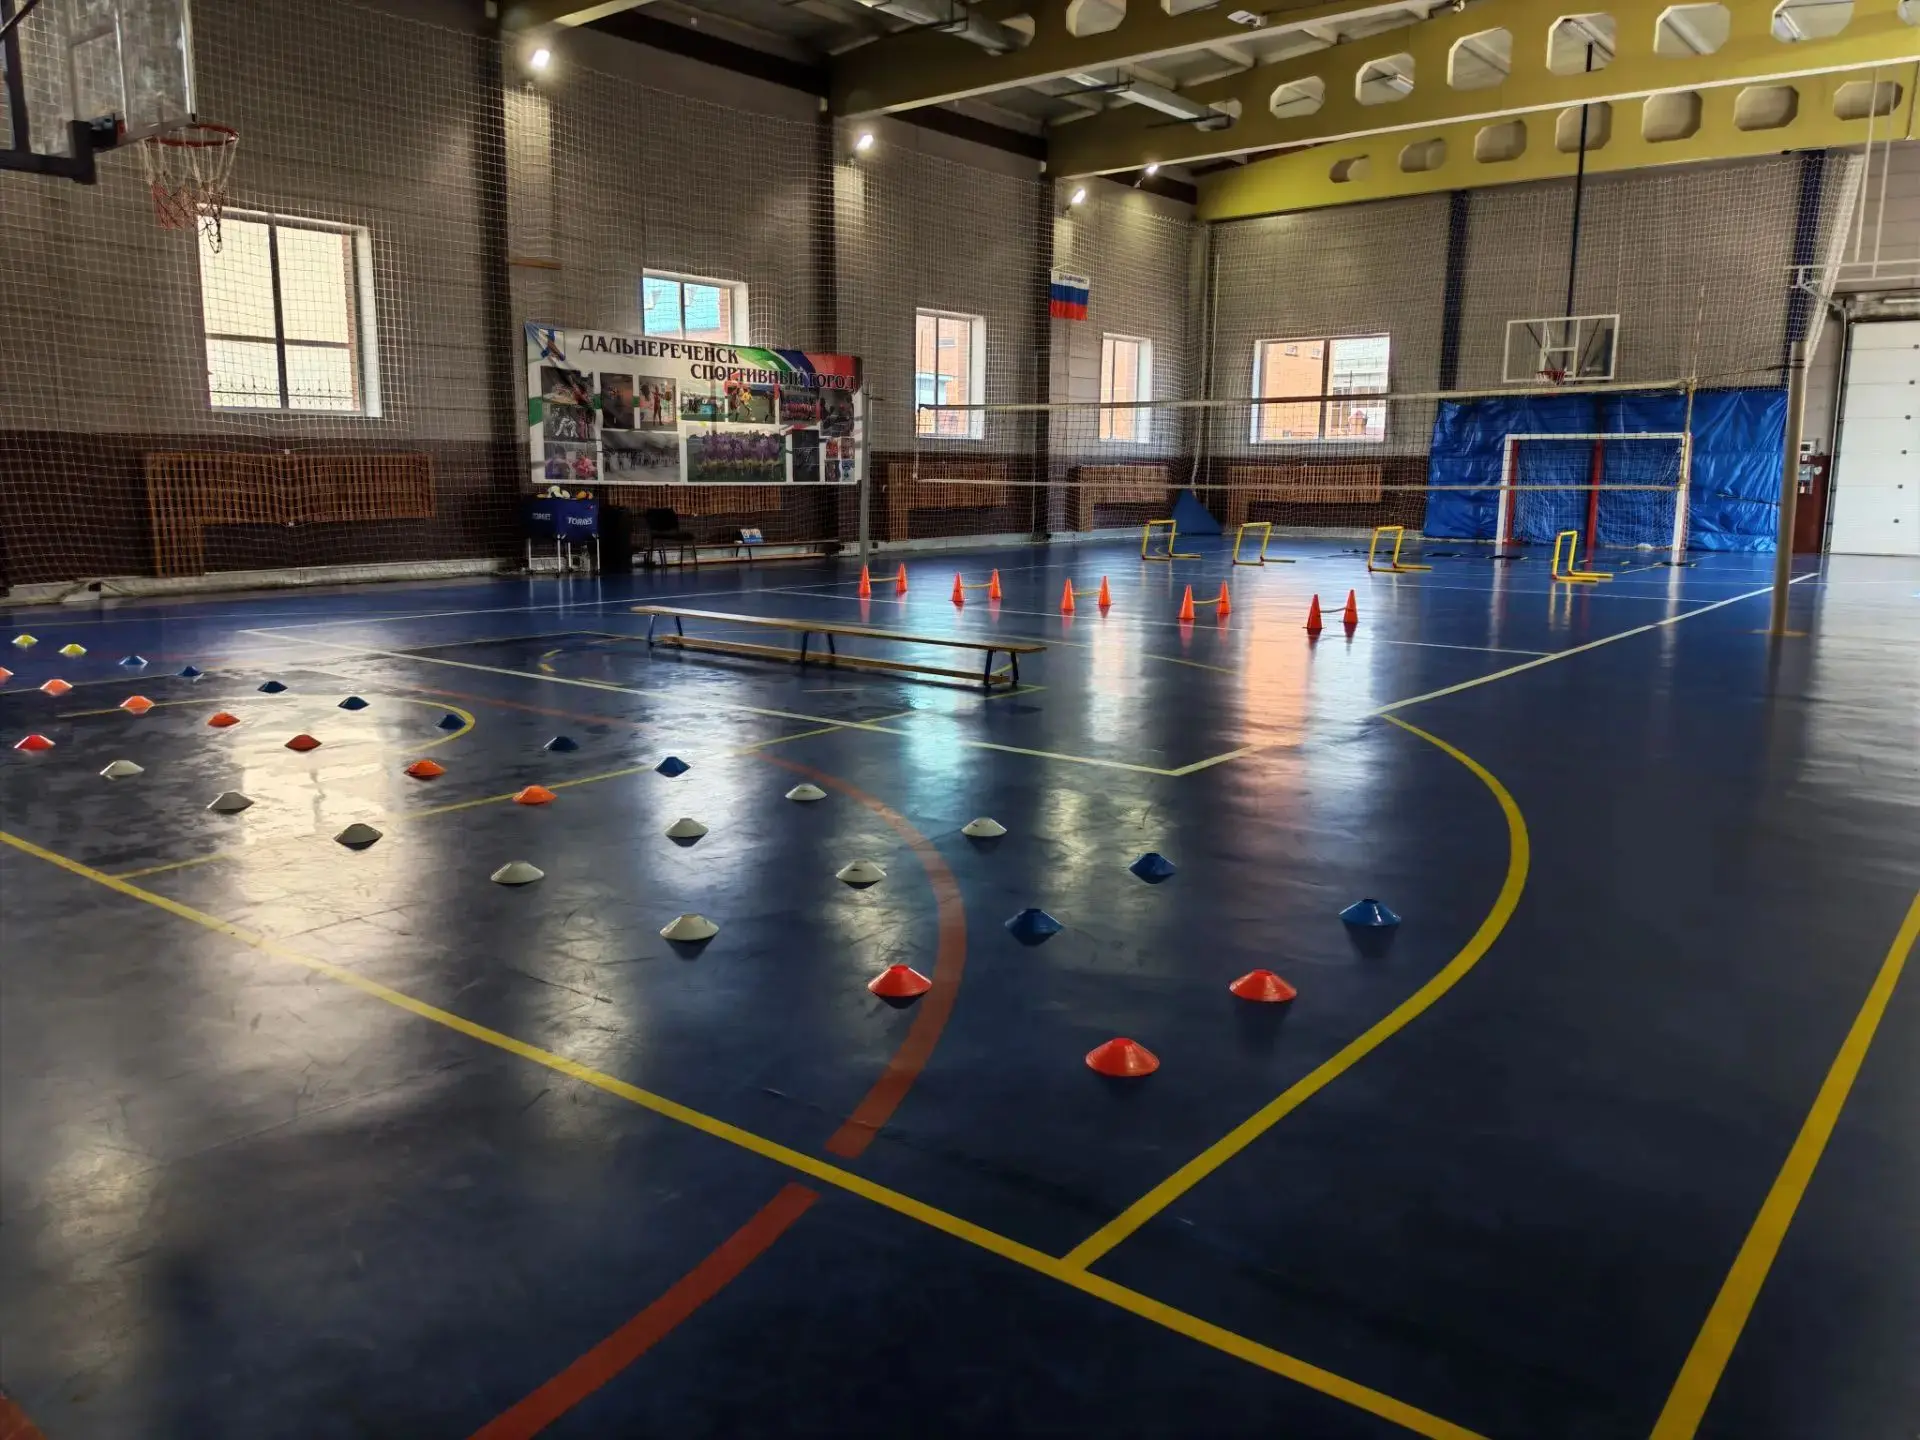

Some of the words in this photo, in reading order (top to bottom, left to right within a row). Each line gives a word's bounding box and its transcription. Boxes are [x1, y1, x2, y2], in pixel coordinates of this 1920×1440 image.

[579, 334, 739, 365] ДАЛЬНЕРЕЧЕНСК
[690, 363, 804, 387] СПОРТИВНЫЙ
[809, 372, 857, 392] ГОРОД
